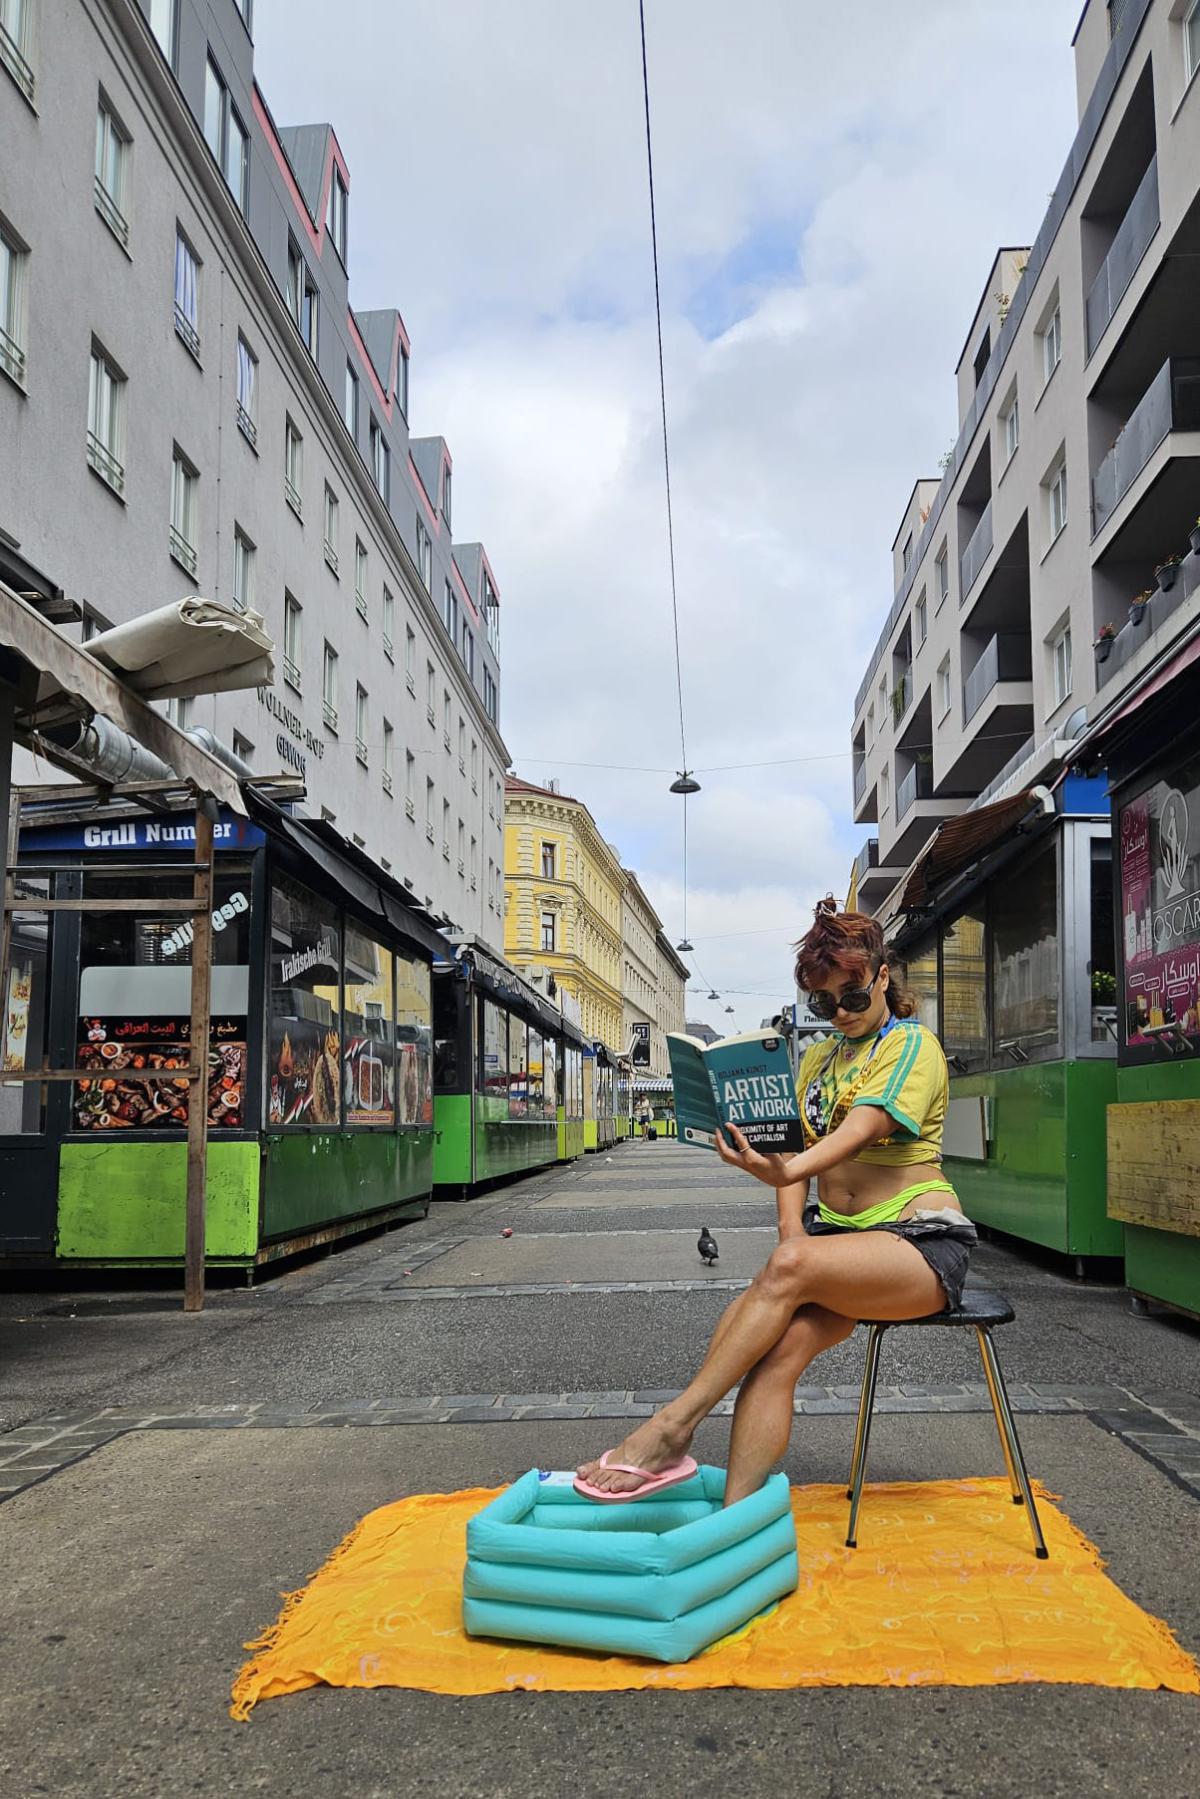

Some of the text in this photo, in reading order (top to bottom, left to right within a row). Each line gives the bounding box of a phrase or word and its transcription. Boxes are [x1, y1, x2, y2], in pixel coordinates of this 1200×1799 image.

[84, 823, 136, 847] Grill
[145, 823, 232, 843] Numer
[1153, 897, 1200, 944] OSCAR
[281, 936, 331, 983] Irakische Grill
[1161, 953, 1200, 993] اوسكار
[724, 1074, 789, 1103] ARTIST
[729, 1102, 746, 1121] AT
[749, 1098, 796, 1118] WORK
[748, 1133, 785, 1143] CAPITALISM
[766, 1123, 774, 1132] OF
[776, 1123, 788, 1132] ART
